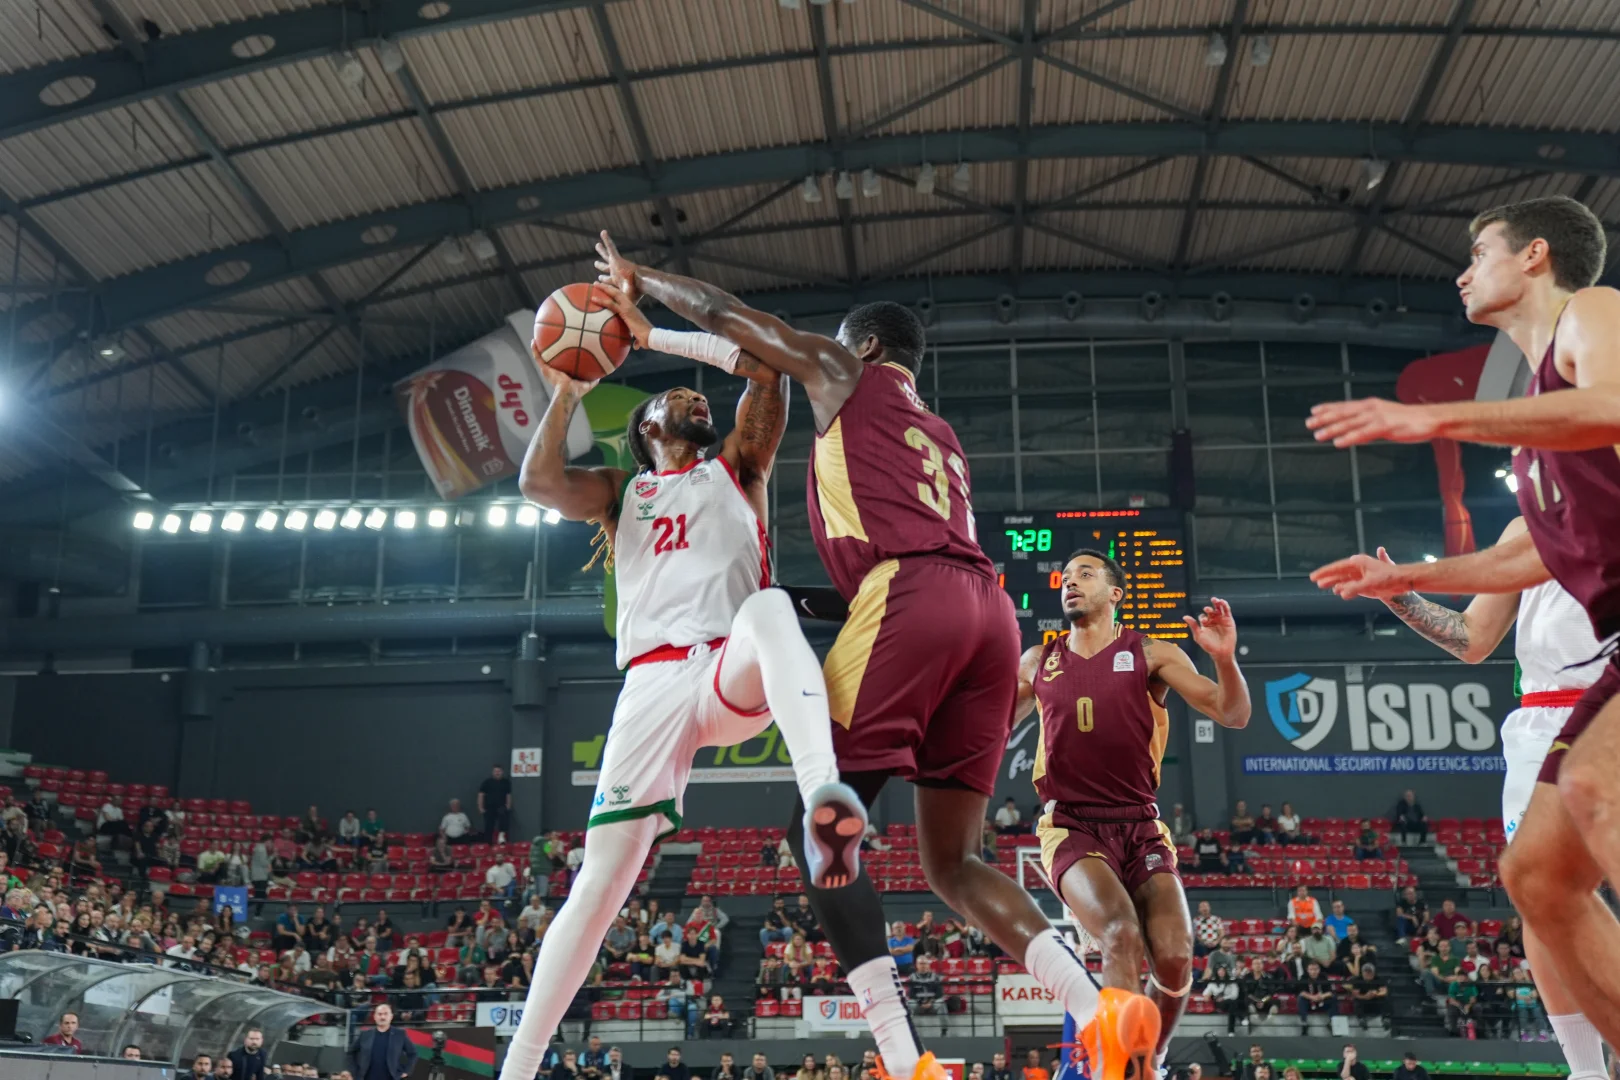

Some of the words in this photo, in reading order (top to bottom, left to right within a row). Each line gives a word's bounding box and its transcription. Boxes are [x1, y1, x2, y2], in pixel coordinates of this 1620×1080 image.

[497, 373, 530, 427] dyo
[454, 386, 492, 452] Dinamik
[652, 514, 690, 557] 21
[1005, 529, 1052, 552] 7:28
[1037, 619, 1064, 632] SCORE
[1076, 696, 1094, 733] 0
[1198, 726, 1212, 738] B1
[513, 763, 540, 773] BLOK
[1245, 756, 1332, 772] INTERNATIONAL
[1334, 756, 1387, 772] SECURITY
[1390, 756, 1415, 771] AND
[1417, 756, 1468, 771] DEFENCE
